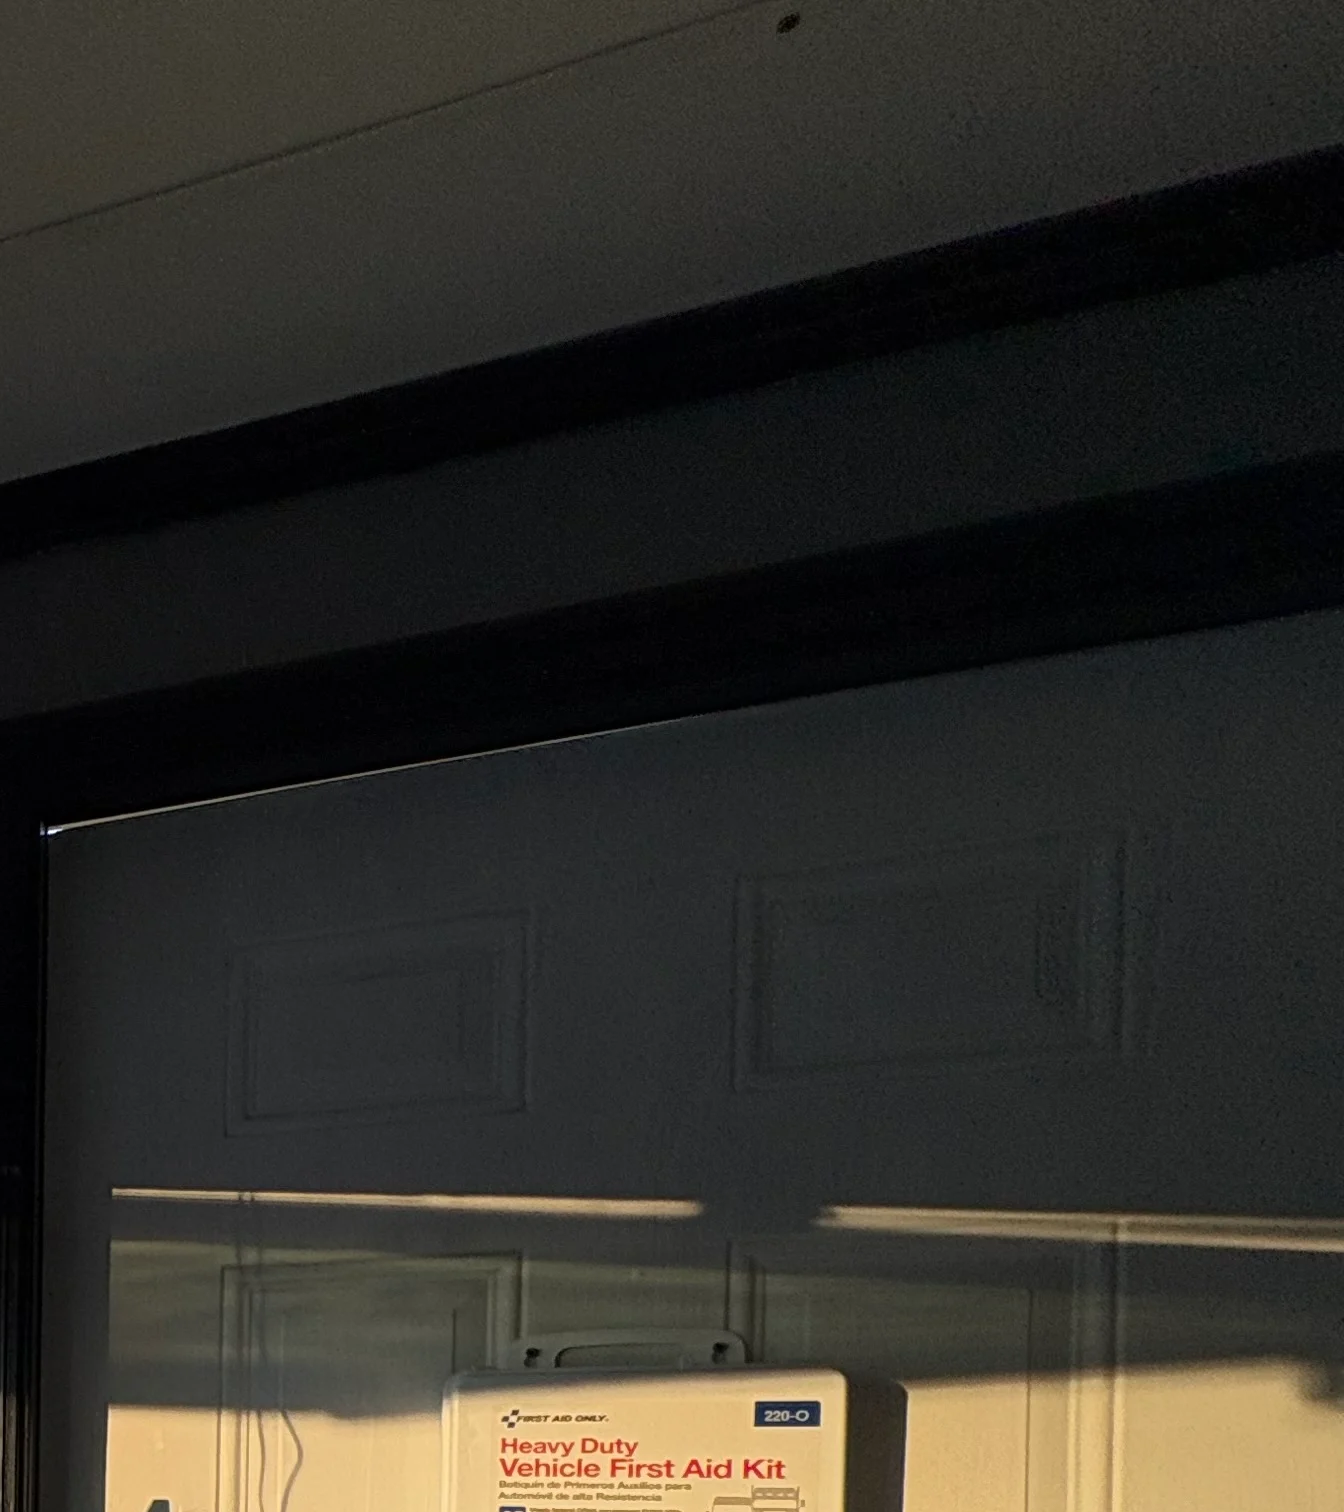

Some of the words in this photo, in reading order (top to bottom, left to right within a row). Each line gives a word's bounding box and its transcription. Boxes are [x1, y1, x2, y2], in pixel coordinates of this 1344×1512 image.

[500, 1437, 575, 1457] Heavy
[581, 1438, 639, 1457] Duty
[499, 1458, 601, 1477] Vehicle
[610, 1458, 674, 1479] First
[682, 1458, 733, 1479] Aid
[743, 1459, 787, 1480] Kit
[546, 1481, 561, 1489] de
[564, 1481, 615, 1489] Primeros
[665, 1483, 692, 1491] para
[555, 1492, 570, 1500] de
[596, 1492, 662, 1502] Resistencia
